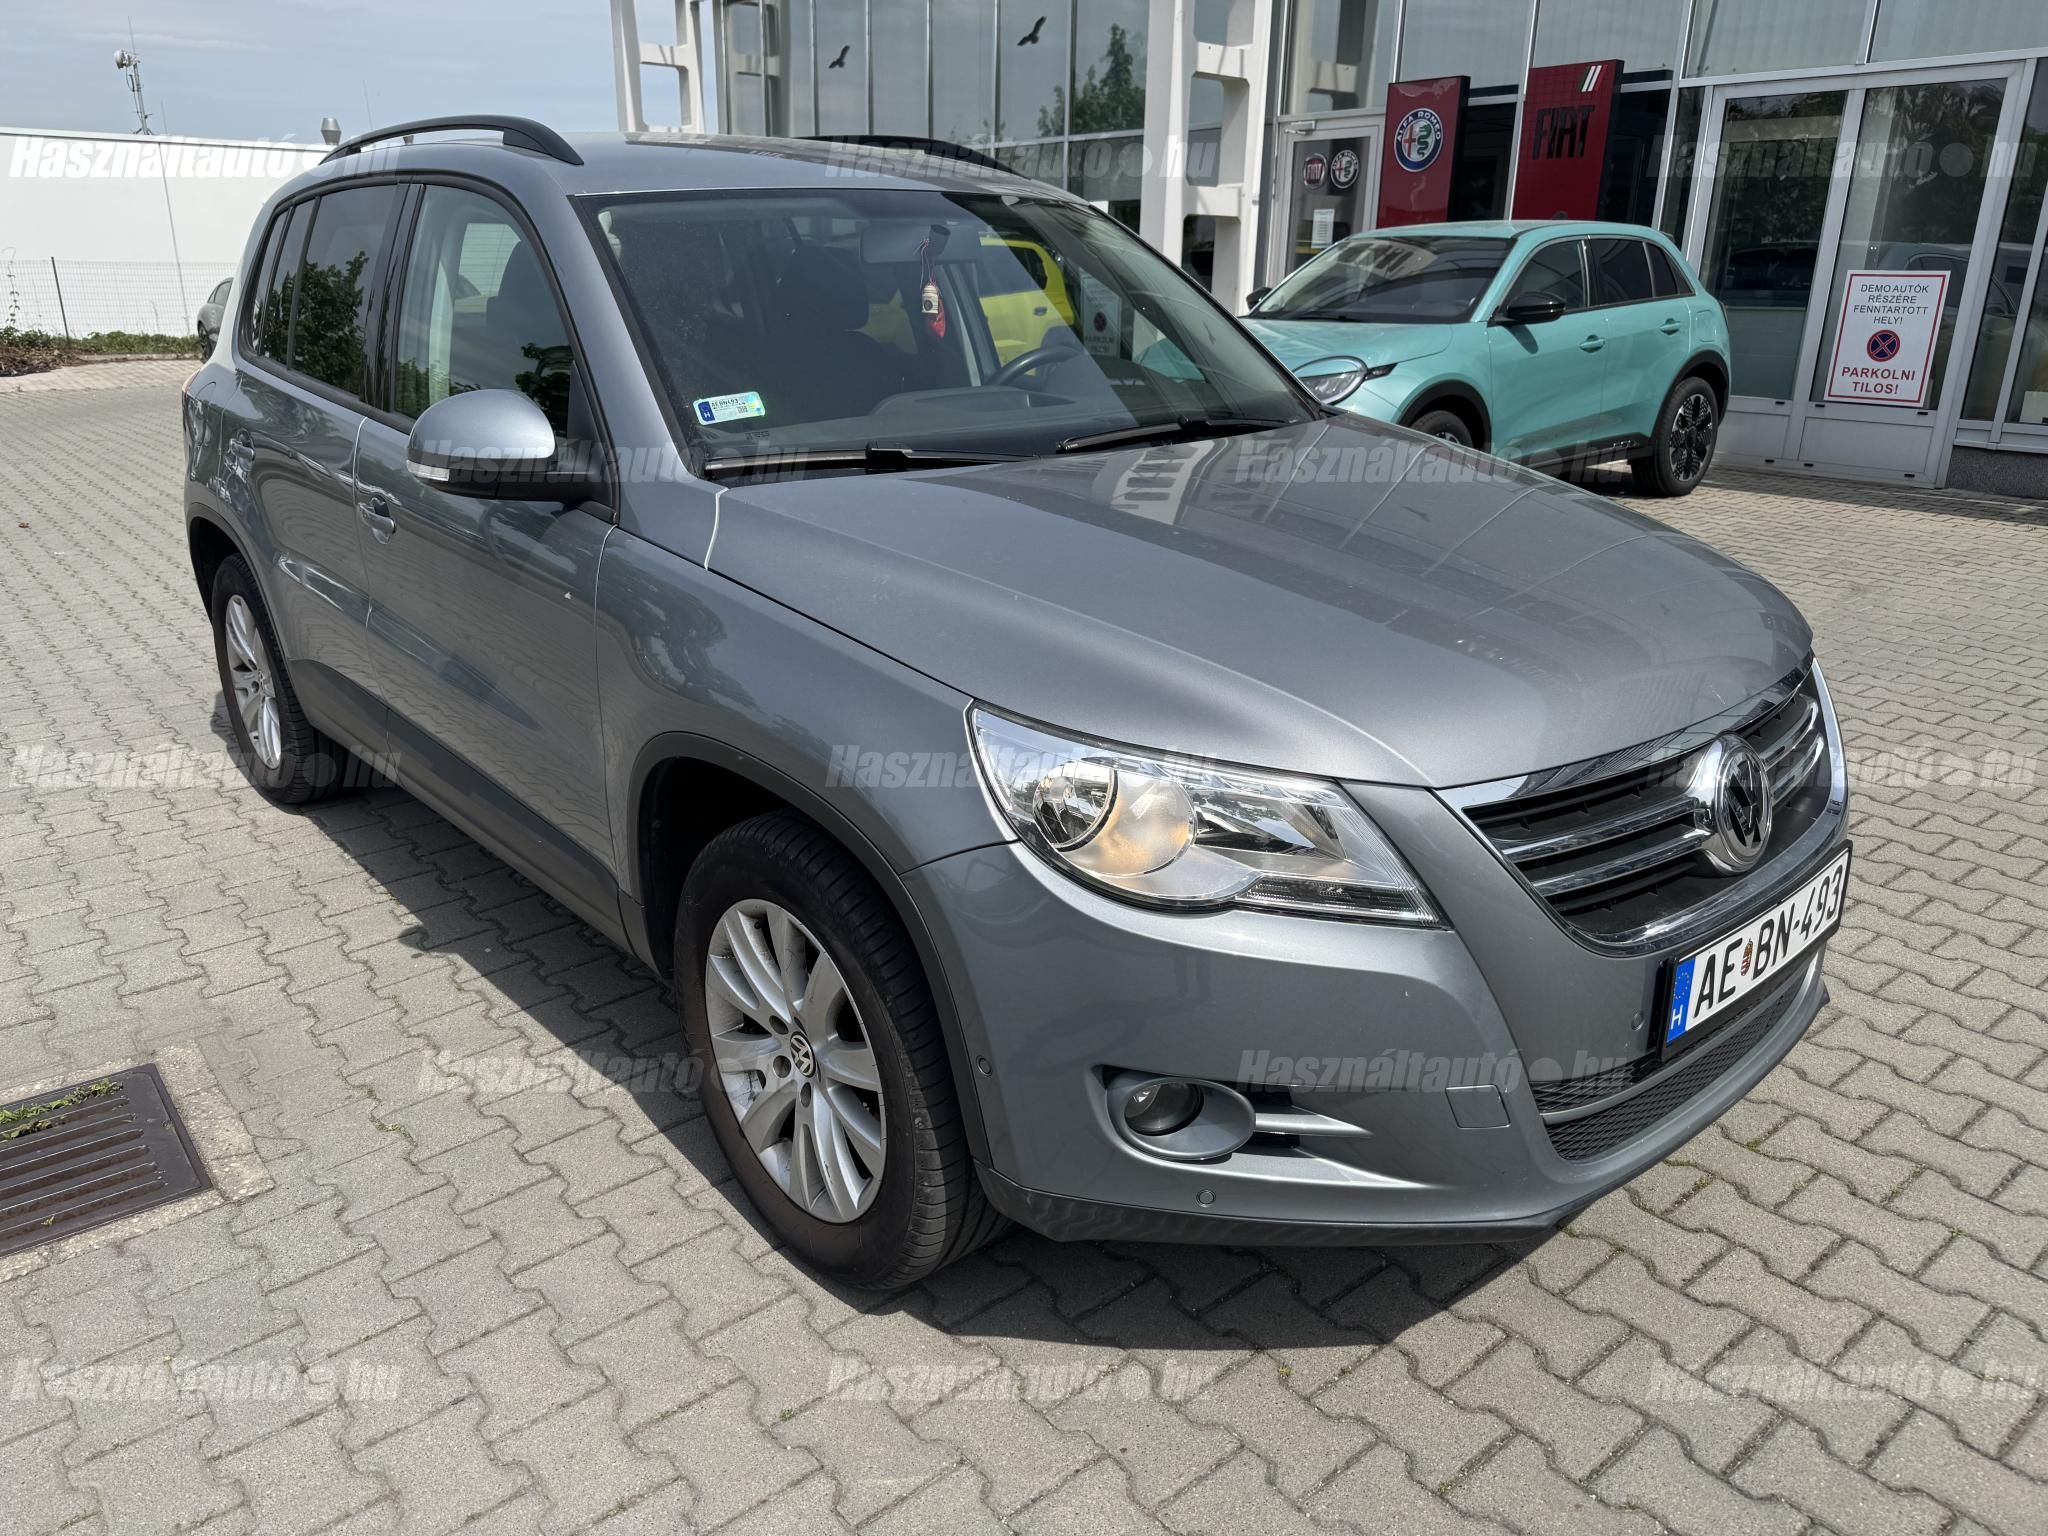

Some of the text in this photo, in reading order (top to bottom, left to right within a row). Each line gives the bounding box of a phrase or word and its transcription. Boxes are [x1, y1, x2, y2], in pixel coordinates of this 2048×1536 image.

[1417, 111, 1441, 140] ROMEO
[1532, 105, 1595, 160] FIAT
[1860, 283, 1929, 294] DEMO AUTÓK
[1868, 294, 1917, 304] RÉSZÉRE
[1853, 304, 1928, 315] FENNTARTOTT
[1873, 316, 1903, 325] HELY!
[1841, 366, 1915, 381] PARKOLNI
[1852, 381, 1899, 395] TILOS!
[1694, 937, 1743, 1018] AE
[1670, 1004, 1683, 1030] H
